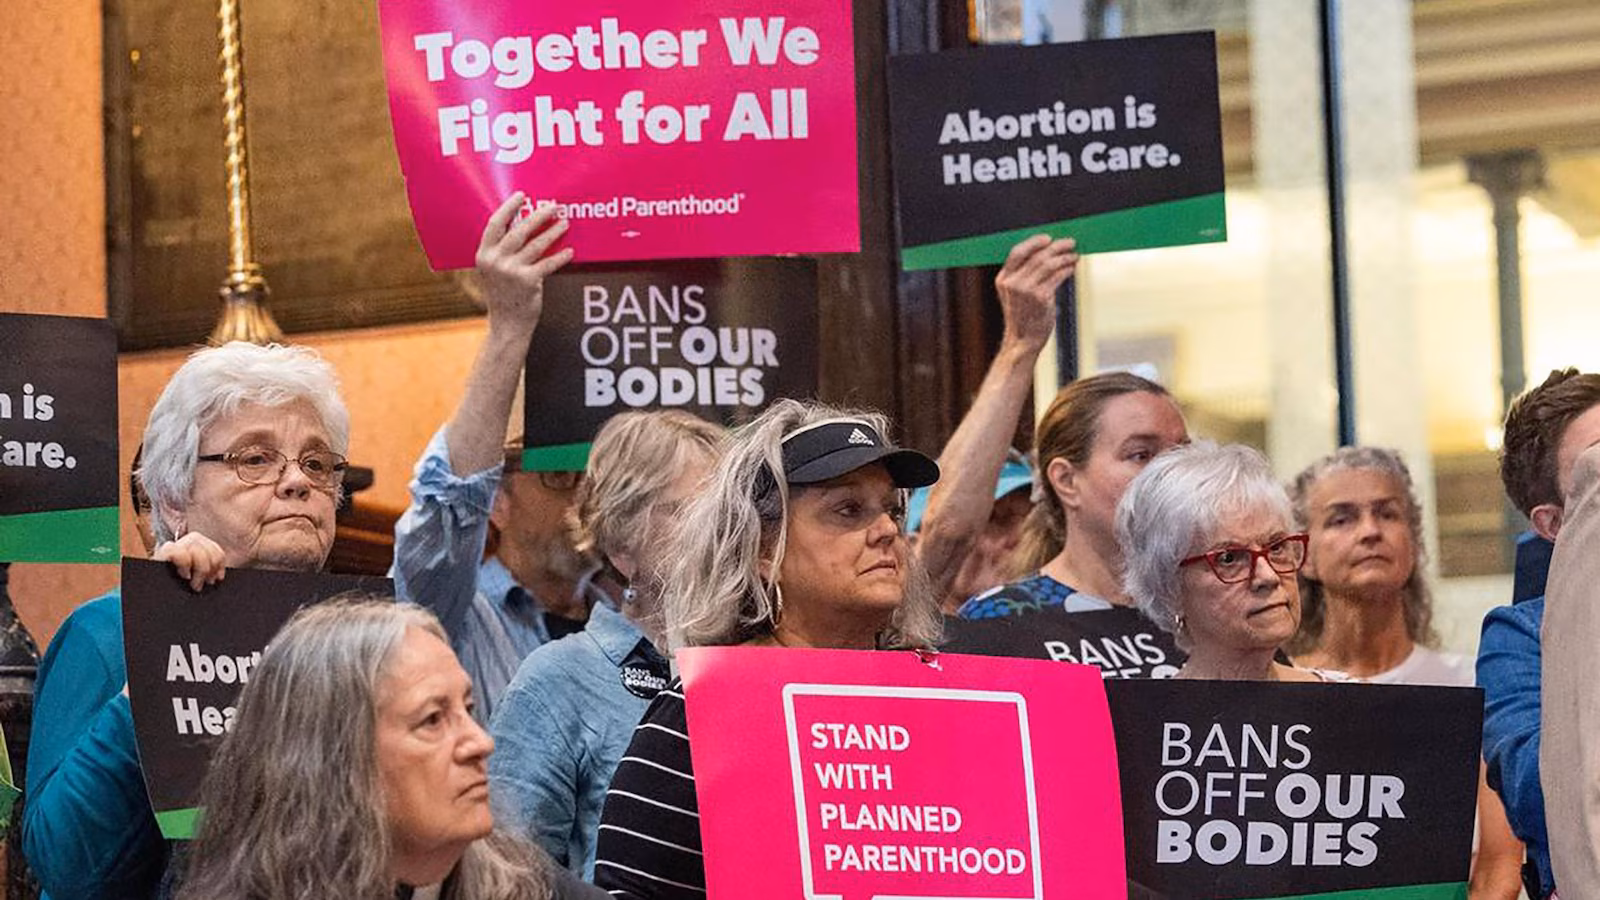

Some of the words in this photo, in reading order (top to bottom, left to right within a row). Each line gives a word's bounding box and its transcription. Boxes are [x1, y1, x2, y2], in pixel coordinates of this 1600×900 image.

[414, 18, 707, 89] Together
[719, 16, 821, 66] We
[437, 95, 604, 164] Fight
[615, 90, 710, 145] for
[722, 88, 810, 141] All
[938, 100, 1115, 144] Abortion
[1124, 95, 1157, 129] is
[942, 144, 1072, 185] Health
[1080, 141, 1182, 173] Care.
[582, 284, 707, 325] BANS
[580, 325, 674, 366] OFF
[679, 325, 779, 367] OUR
[22, 382, 55, 422] is
[584, 366, 765, 407] BODIES
[0, 434, 77, 470] are.
[166, 642, 264, 684] Abort
[1044, 633, 1165, 669] BANS
[171, 697, 238, 736] Hea
[811, 723, 910, 751] STAND
[1161, 722, 1312, 769] BANS
[814, 762, 893, 791] WITH
[1155, 770, 1268, 817] OFF
[1274, 773, 1406, 819] OUR
[820, 802, 962, 833] PLANNED
[824, 844, 1026, 875] PARENTHOOD
[1156, 819, 1380, 867] BODIES
